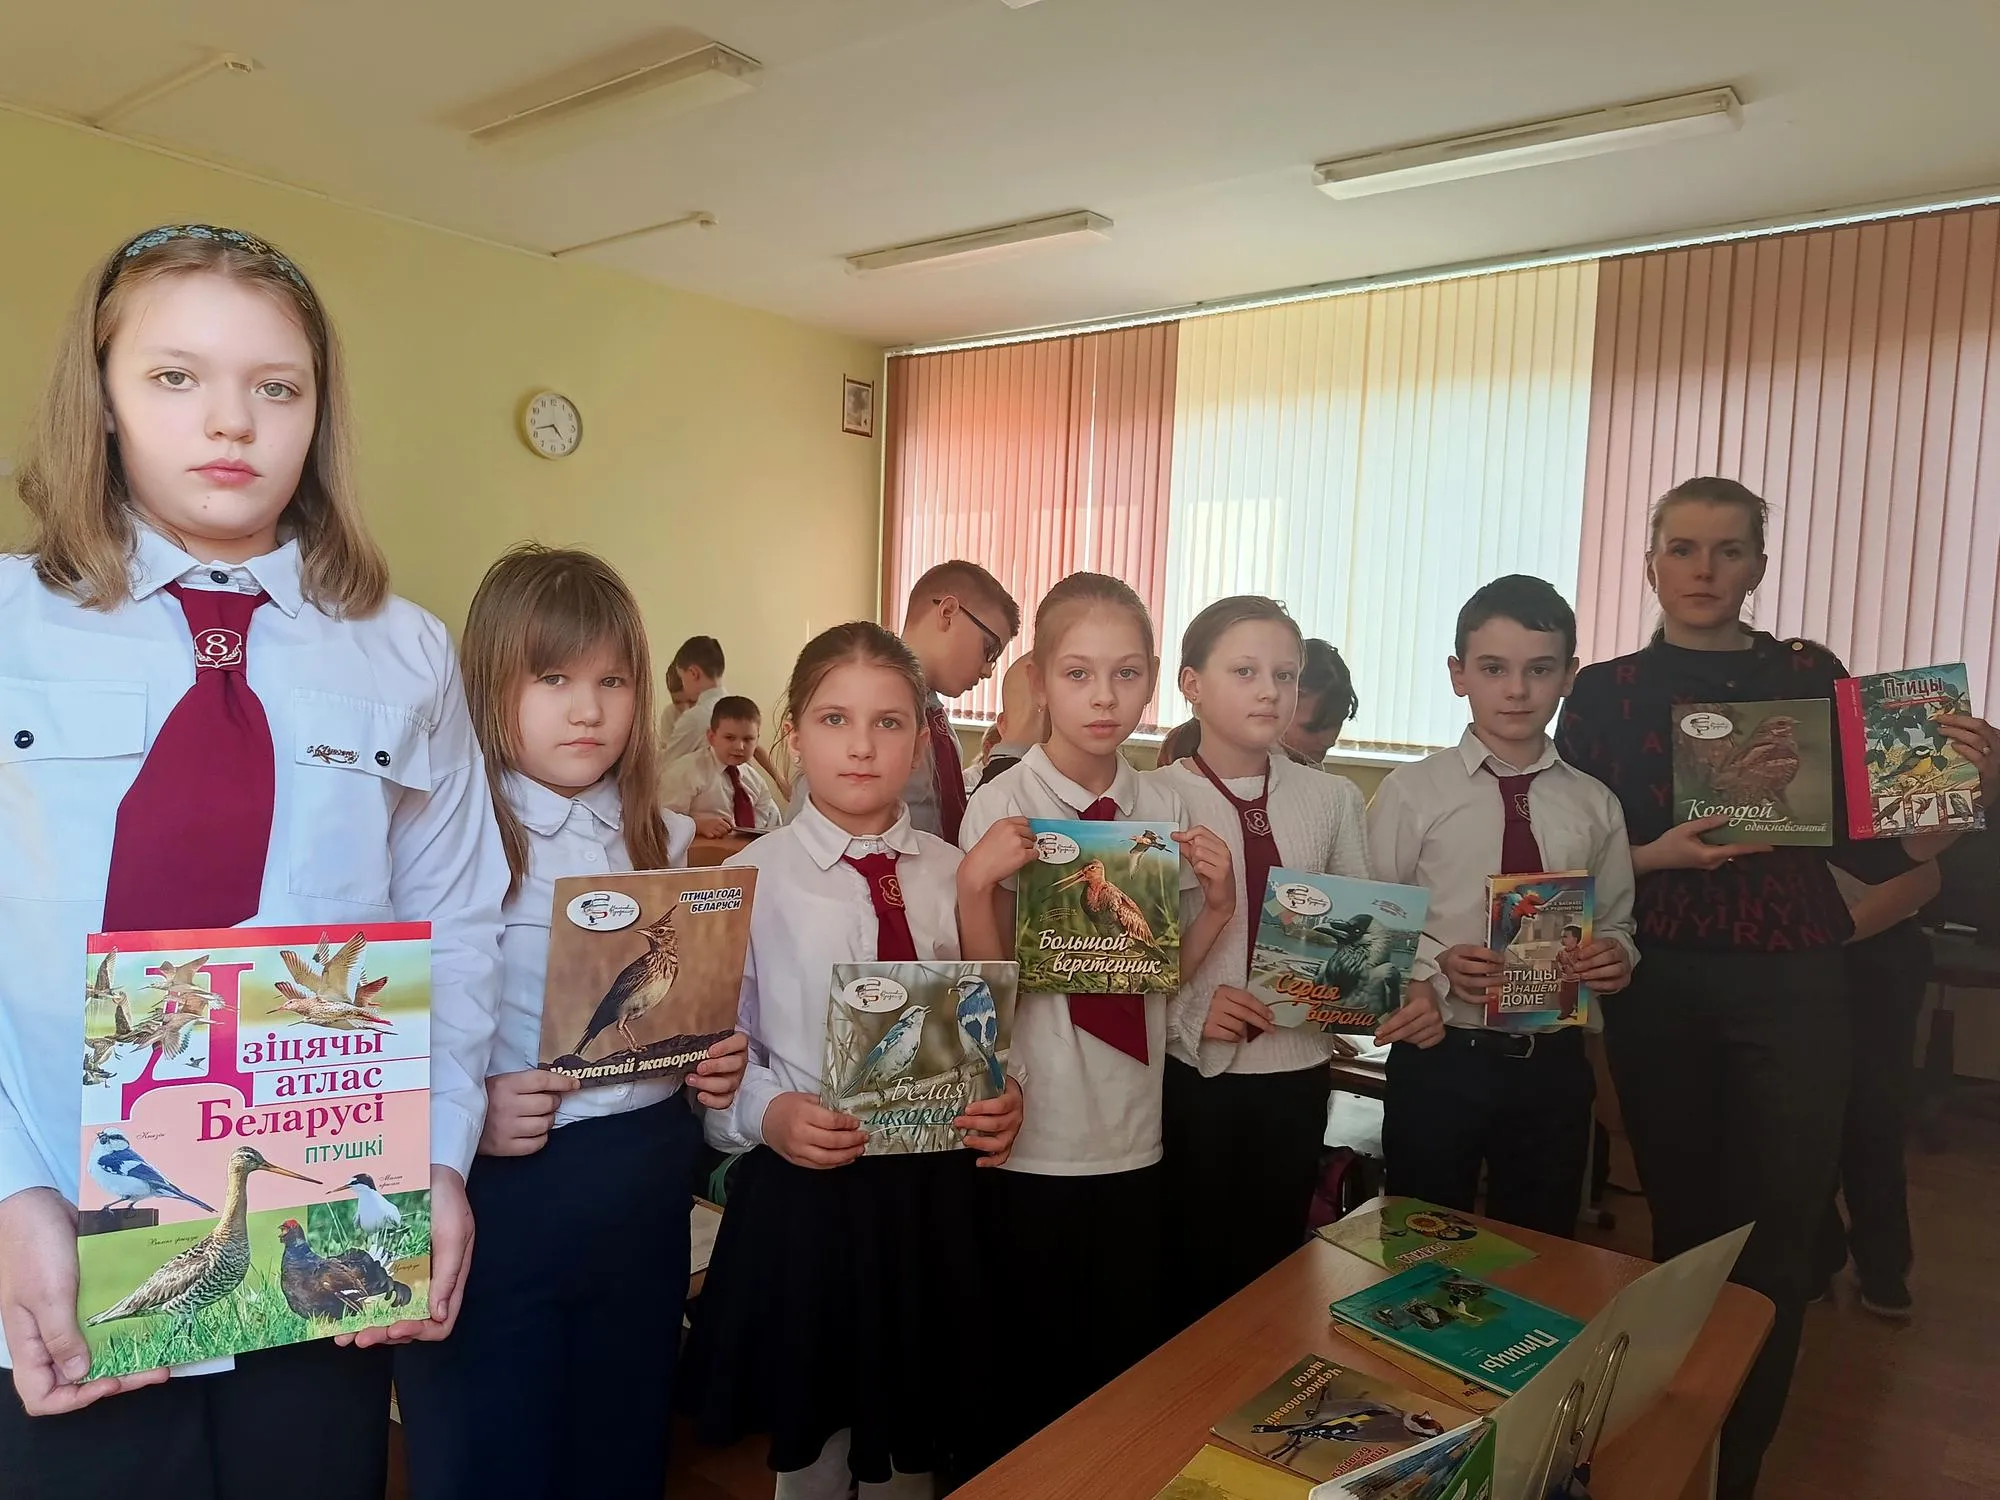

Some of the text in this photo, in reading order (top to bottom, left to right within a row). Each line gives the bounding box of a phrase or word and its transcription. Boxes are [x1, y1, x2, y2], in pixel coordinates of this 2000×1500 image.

[204, 633, 228, 656] 8
[1883, 677, 1944, 699] Птицы
[680, 887, 743, 903] ПТИЦА ГОДА
[690, 899, 742, 914] БЕЛАРУСИ
[1038, 928, 1130, 951] Большой
[1052, 951, 1163, 983] веретенник
[1503, 969, 1557, 982] ПТИЦЫ
[1275, 972, 1341, 1006] Серая
[1500, 993, 1544, 1007] ДОМЕ
[1502, 983, 1558, 993] В НАШЕМ
[1305, 1002, 1377, 1033] ворона
[637, 1048, 711, 1074] жаворон
[275, 1064, 384, 1098] атлас
[890, 1076, 967, 1102] Белая
[197, 1094, 385, 1143] Беларусі
[1476, 1328, 1560, 1374] Птицы
[1290, 1360, 1326, 1388] щегол
[1263, 1367, 1344, 1427] Черноголовый
[1331, 1446, 1372, 1479] Беларуси
